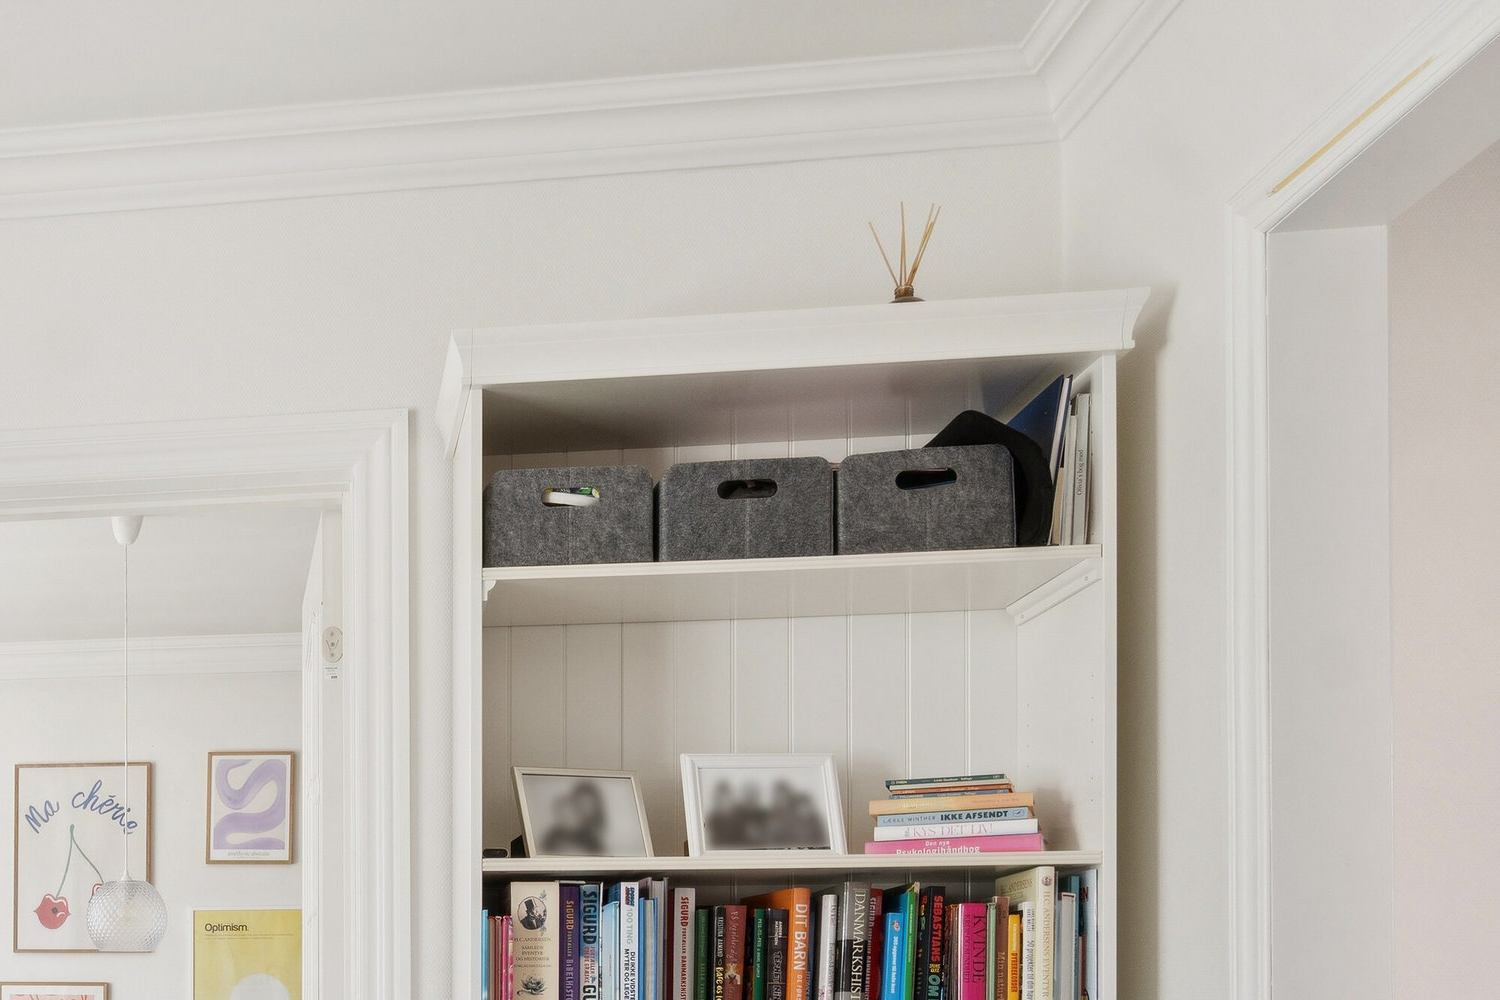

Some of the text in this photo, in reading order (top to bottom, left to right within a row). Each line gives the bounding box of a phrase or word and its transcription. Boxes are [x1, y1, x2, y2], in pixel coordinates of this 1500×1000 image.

[25, 800, 60, 834] Ma
[940, 812, 963, 821] IKKE
[965, 810, 1009, 820] AFSENDT
[913, 826, 937, 837] KYS
[941, 825, 965, 836] DET
[583, 890, 597, 945] SIGURD
[795, 904, 807, 927] DIT
[931, 896, 944, 962] SEBASTIANS
[794, 931, 807, 970] BARN
[973, 914, 987, 983] KVINDE
[1027, 940, 1035, 948] 50
[631, 951, 636, 961] DU
[997, 952, 1006, 970] Min
[1026, 949, 1036, 972] projekter
[624, 971, 630, 981] OG
[928, 974, 941, 997] OM
